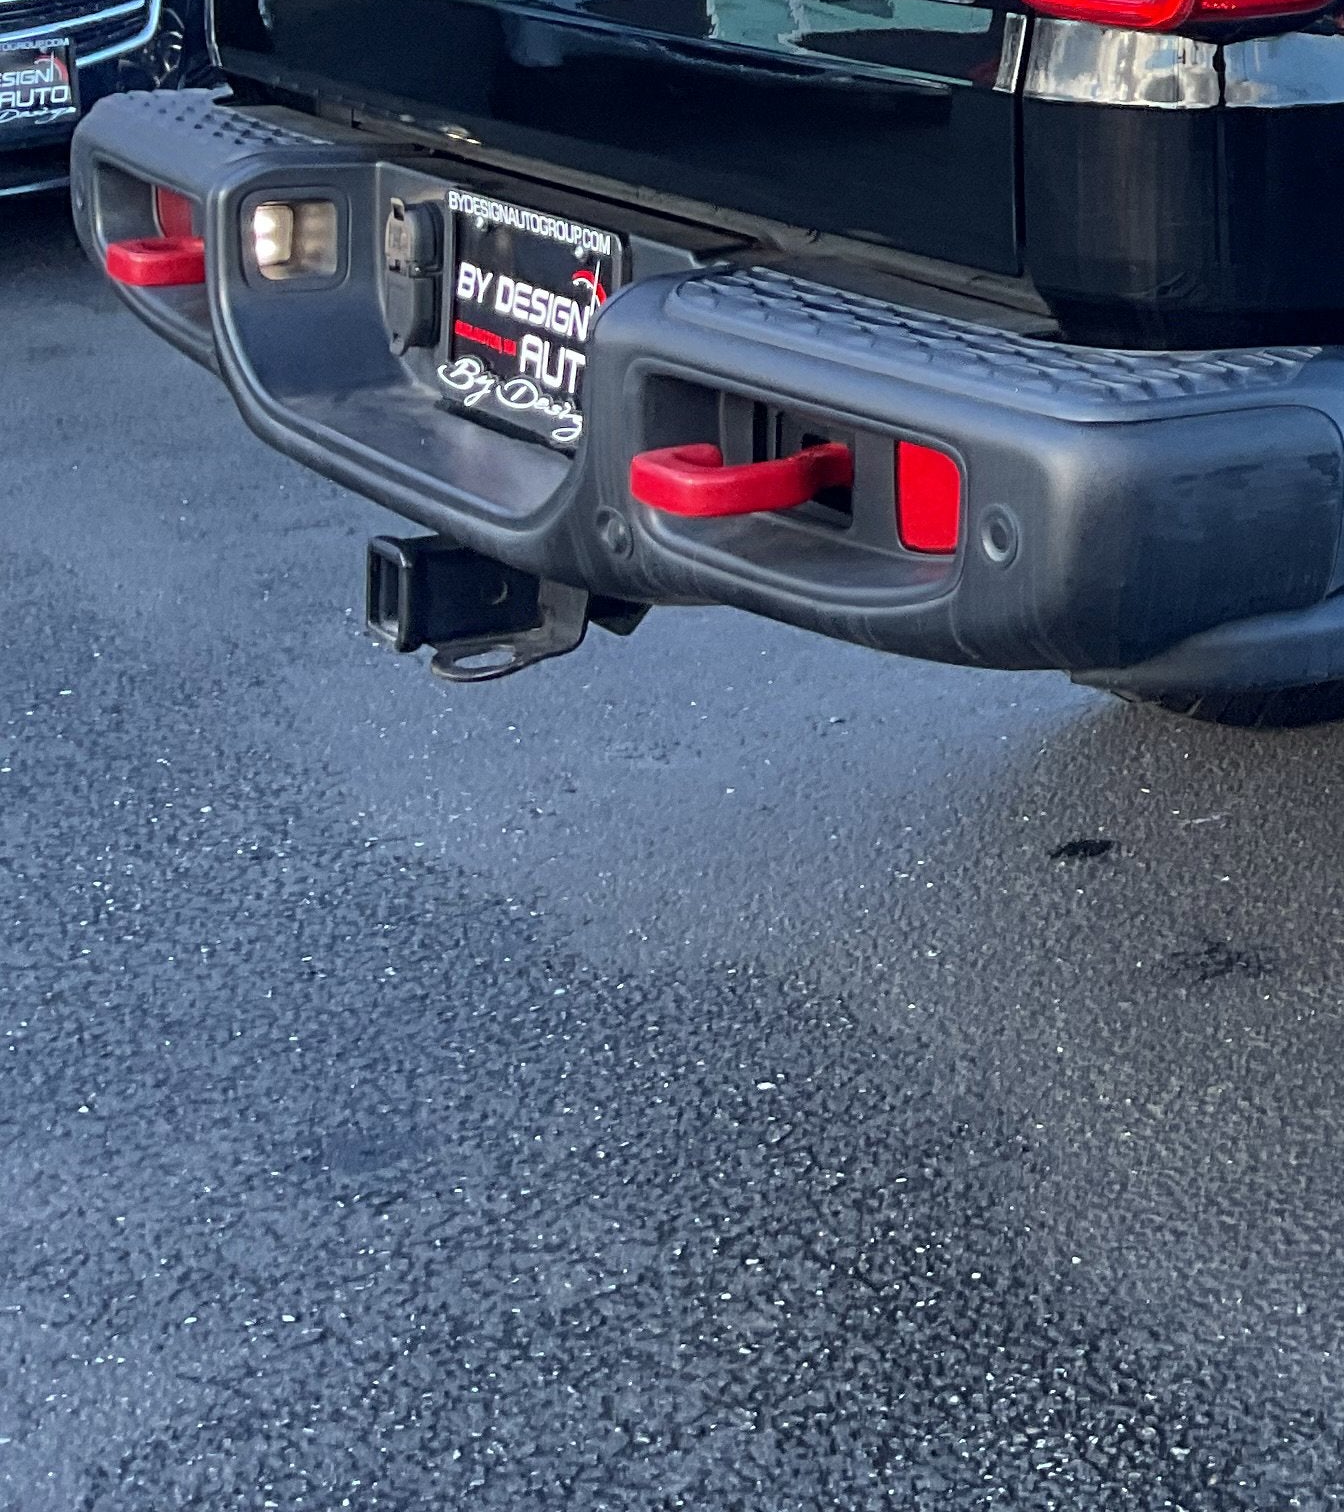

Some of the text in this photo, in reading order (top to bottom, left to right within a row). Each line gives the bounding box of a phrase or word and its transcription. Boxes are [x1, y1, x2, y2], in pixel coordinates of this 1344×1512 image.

[0, 68, 50, 88] SIGN
[448, 190, 612, 256] BYDESIGNAUTOGROUP.COM
[456, 260, 494, 304] BY
[494, 274, 591, 342] DESIGN
[437, 356, 497, 408] By
[519, 333, 586, 394] AUT
